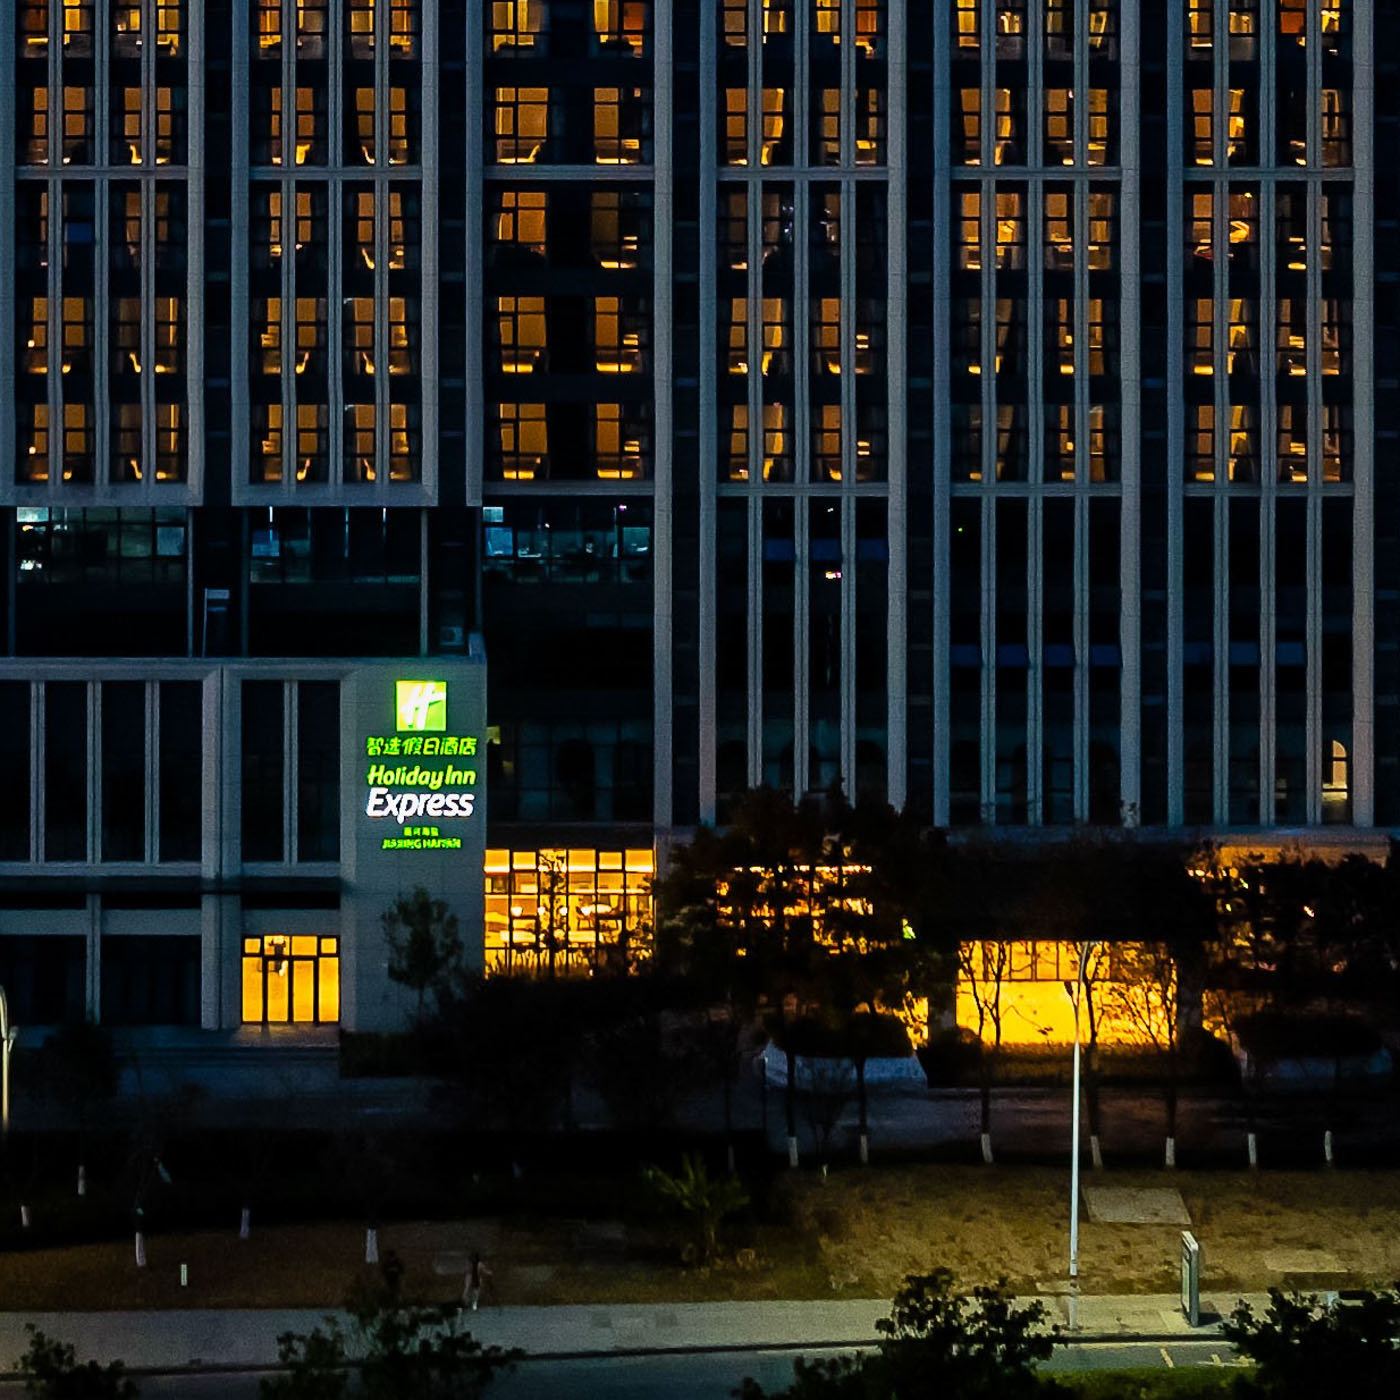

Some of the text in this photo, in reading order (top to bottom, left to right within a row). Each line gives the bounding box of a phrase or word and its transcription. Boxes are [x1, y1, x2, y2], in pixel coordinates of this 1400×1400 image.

[366, 736, 477, 756] 智选假日酒店
[367, 764, 476, 791] Holiday Inn
[366, 787, 475, 824] Express
